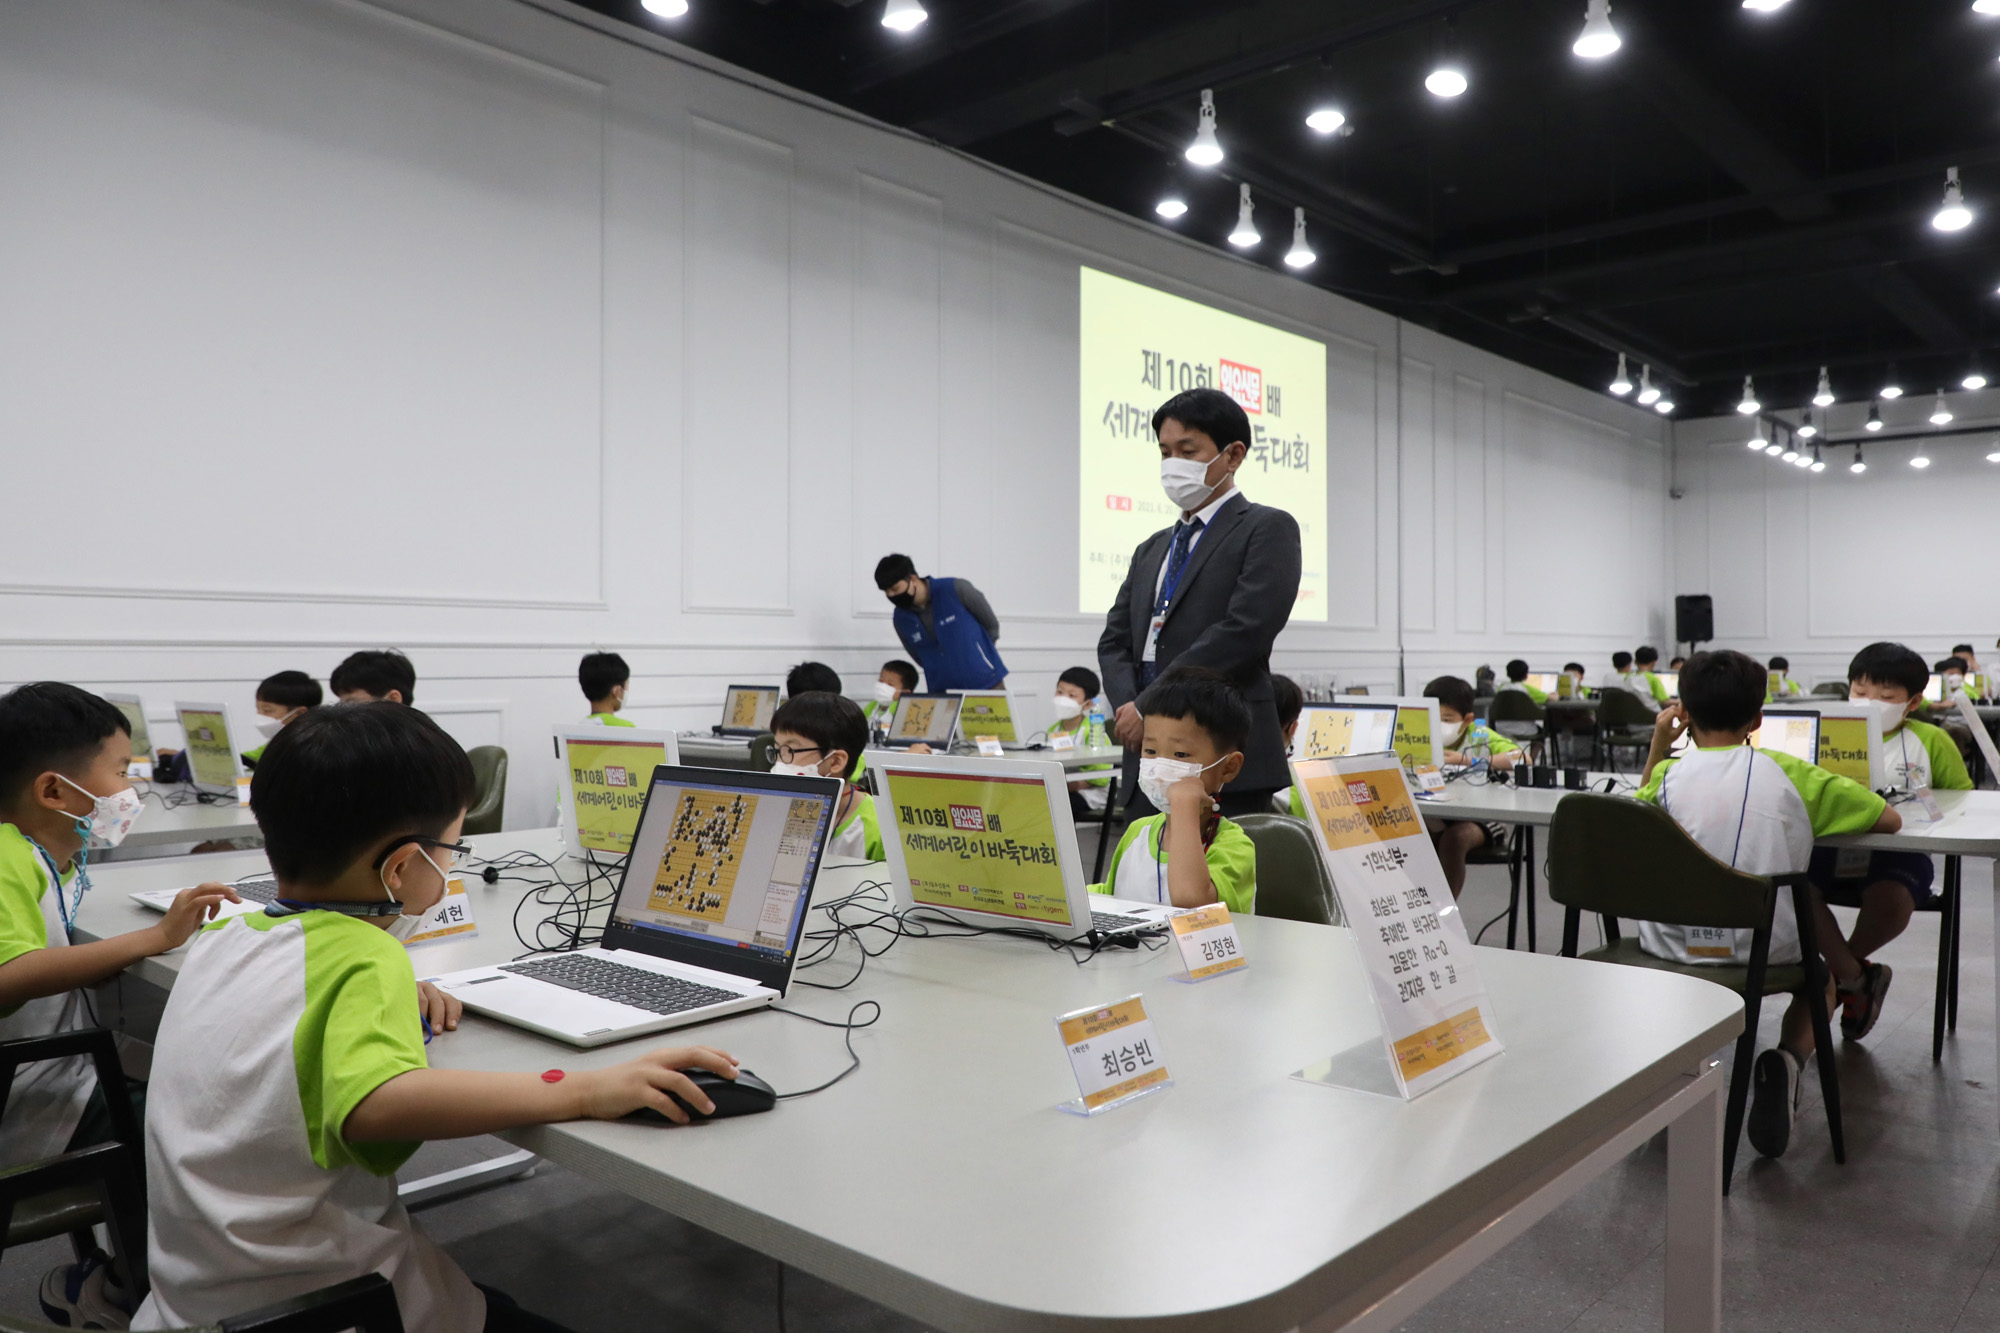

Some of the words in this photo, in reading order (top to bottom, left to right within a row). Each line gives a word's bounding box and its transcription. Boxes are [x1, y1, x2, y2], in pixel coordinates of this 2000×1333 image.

[1267, 384, 1281, 417] 배
[573, 768, 604, 786] 제10회
[605, 767, 627, 786] 일요신문
[628, 772, 638, 787] 배
[1316, 787, 1351, 811] 제10회
[899, 805, 949, 828] 제10회
[950, 807, 984, 830] 일요신문
[987, 814, 1002, 833] 배
[906, 833, 1058, 867] 세계어린이바둑대회
[1362, 847, 1408, 874] -1학년부-
[1370, 894, 1400, 918] 최승빈
[1402, 886, 1431, 909] 김정현
[1380, 922, 1409, 946] 추예헌
[1412, 911, 1440, 934] 박규태
[1200, 935, 1237, 961] 김정현
[1389, 948, 1419, 974] 김윤한
[1422, 939, 1448, 962] Ra-Q
[1397, 975, 1426, 1003] 권지후
[1429, 970, 1442, 990] 한
[1101, 1038, 1154, 1077] 최승빈
